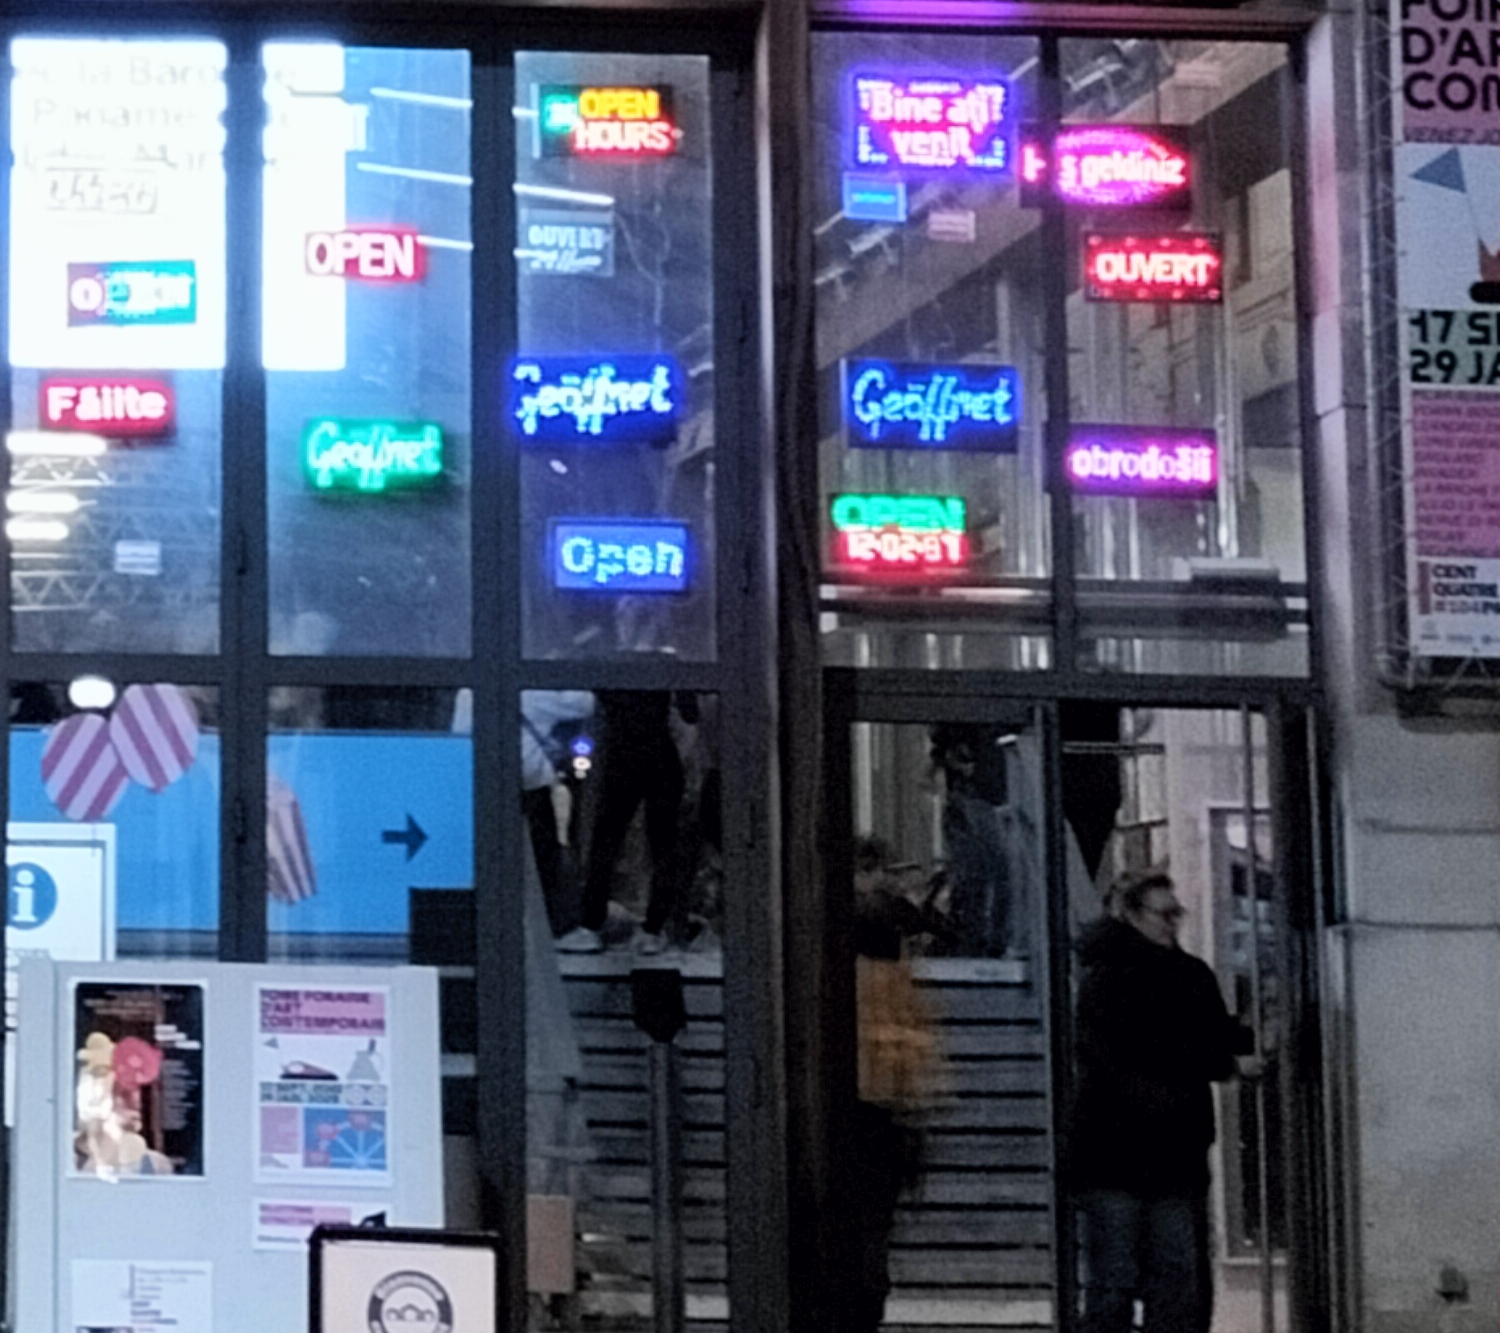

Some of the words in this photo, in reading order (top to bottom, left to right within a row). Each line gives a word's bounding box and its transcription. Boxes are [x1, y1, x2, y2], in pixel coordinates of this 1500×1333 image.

[580, 88, 659, 119] OPEN
[574, 121, 671, 151] HOURS
[305, 234, 415, 277] OPEN
[1097, 251, 1213, 285] OUVERT
[1409, 310, 1453, 344] 17
[1467, 311, 1500, 345] S
[1410, 349, 1457, 383] 29
[832, 495, 965, 531] OPEN
[560, 537, 684, 583] Open
[1432, 564, 1477, 579] CENT
